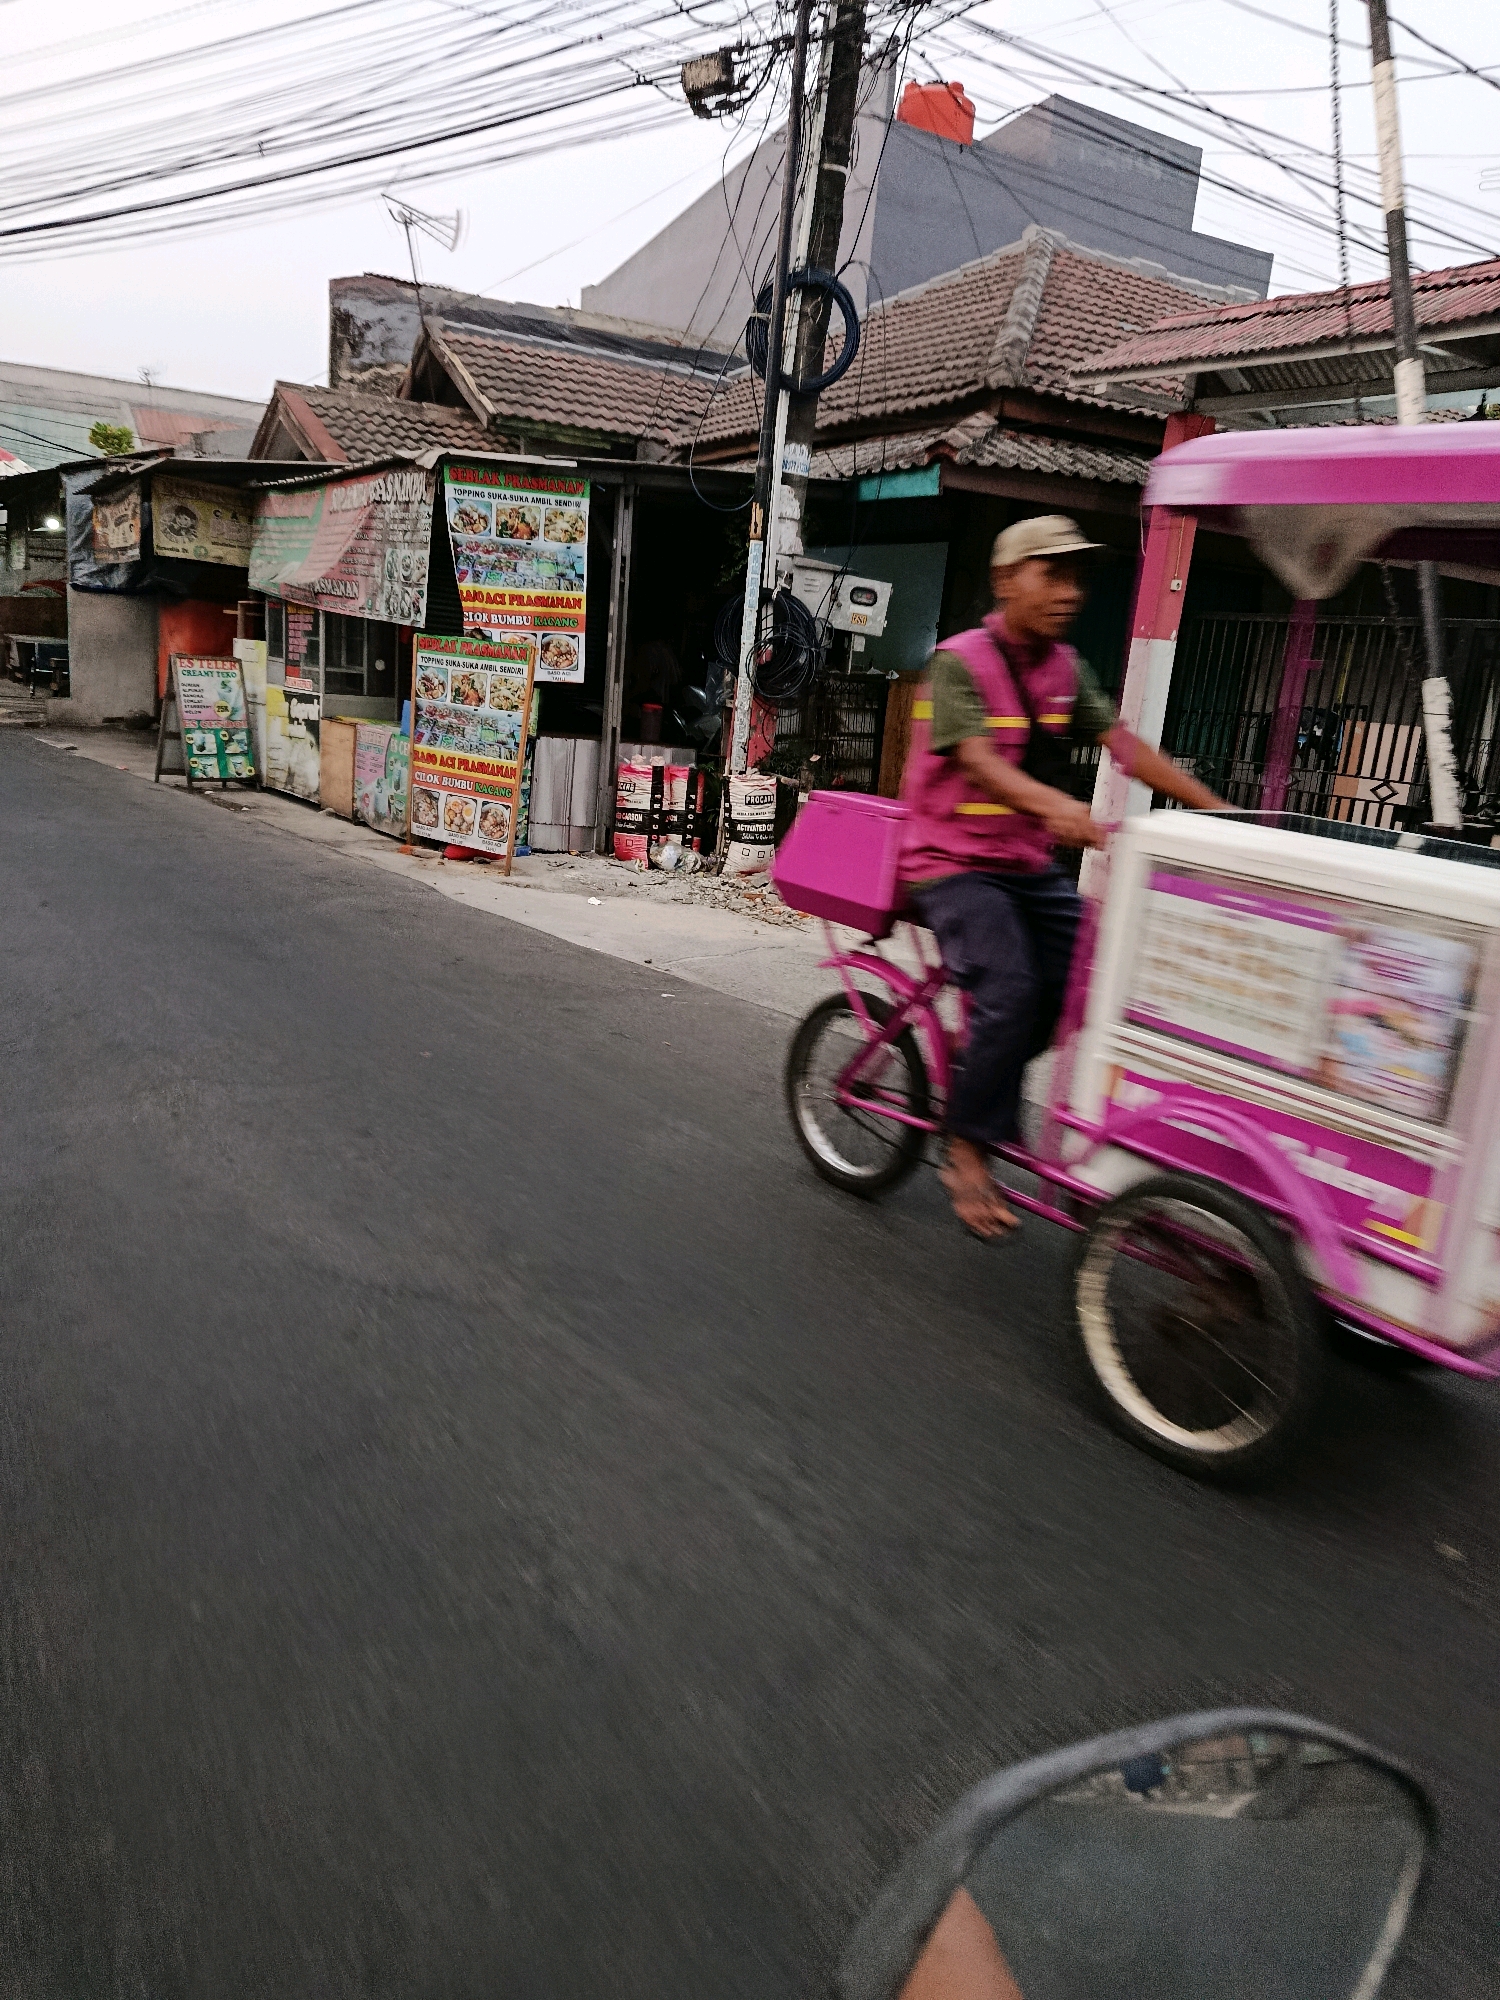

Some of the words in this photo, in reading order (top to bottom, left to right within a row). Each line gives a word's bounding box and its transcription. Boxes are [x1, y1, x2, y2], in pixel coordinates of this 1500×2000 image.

[449, 467, 501, 486] SEBLAK
[504, 474, 586, 496] PRASMANAN
[453, 488, 486, 499] TOPPING
[487, 491, 530, 504] SUKA-SUKA
[531, 497, 553, 506] AMBIL
[485, 592, 506, 606] ACI
[508, 594, 583, 610] PRASMANAN
[490, 614, 532, 626] BUMBU
[533, 616, 579, 628] KACANG
[419, 637, 458, 653] SEBLAK
[460, 640, 529, 660] PRASMANAN
[179, 659, 195, 669] ES
[198, 660, 238, 670] TELER
[420, 656, 445, 666] TOPPING
[445, 660, 479, 670] SUKA-SUKA
[479, 663, 498, 672] AMBIL
[499, 666, 524, 676] SENDIRI
[439, 755, 456, 769] ACI
[457, 758, 518, 779] PRASMANAN
[414, 771, 440, 785] CILOK
[441, 776, 474, 791] BUMBU
[475, 782, 513, 798] KACANG
